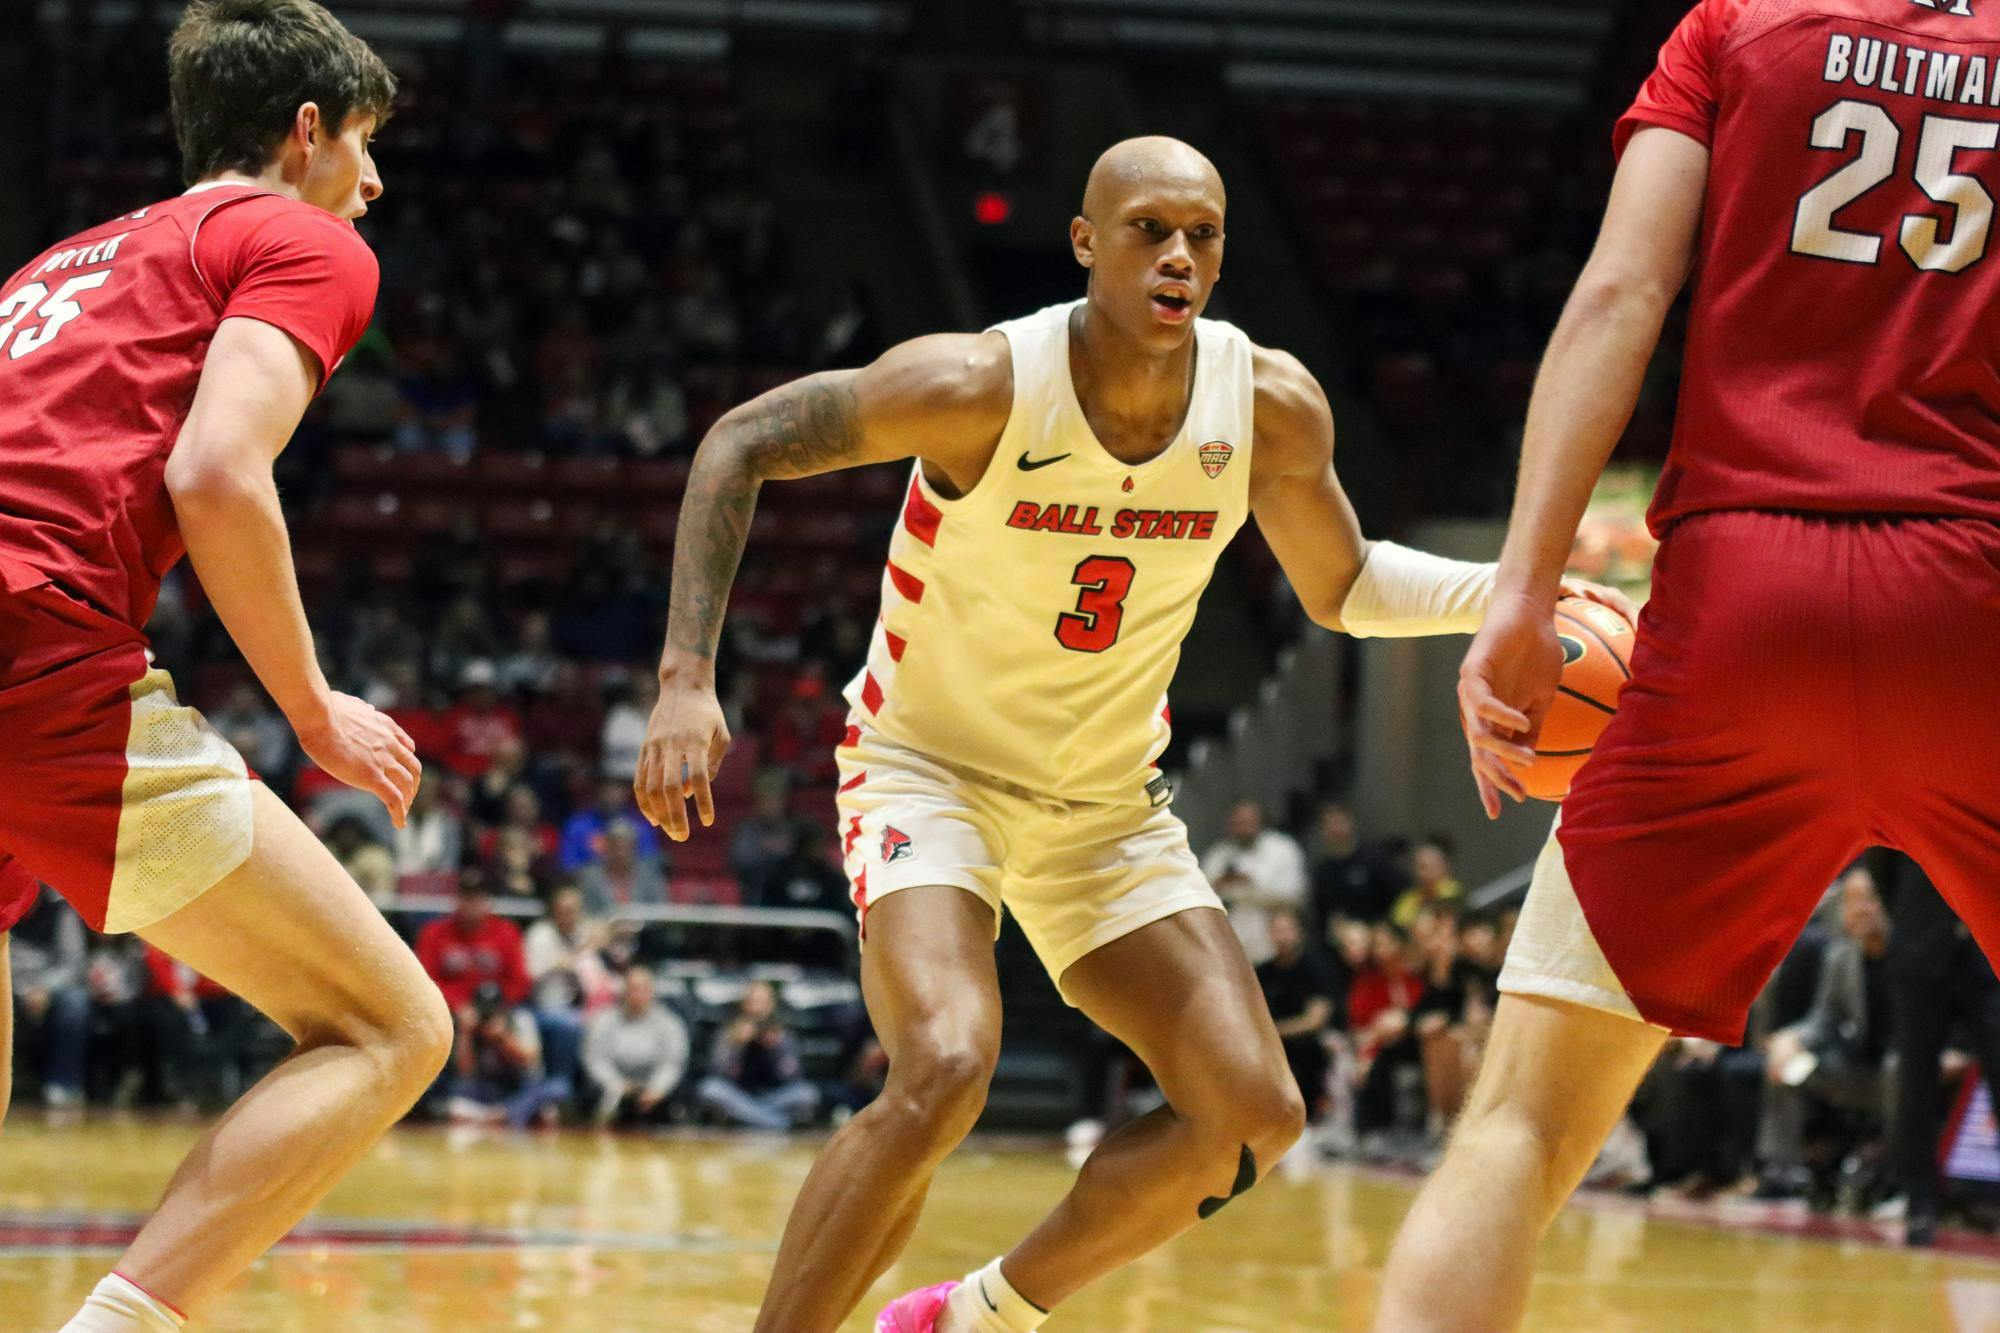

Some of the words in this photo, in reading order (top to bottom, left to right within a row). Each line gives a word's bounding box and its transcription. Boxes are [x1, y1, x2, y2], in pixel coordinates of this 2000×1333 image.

[964, 103, 1022, 171] 4
[1789, 98, 2000, 275] 25
[30, 232, 129, 278] POTTER
[1200, 452, 1231, 464] MAC
[1006, 500, 1103, 536] BALL
[1110, 508, 1219, 540] STATE
[1054, 554, 1136, 653] 3
